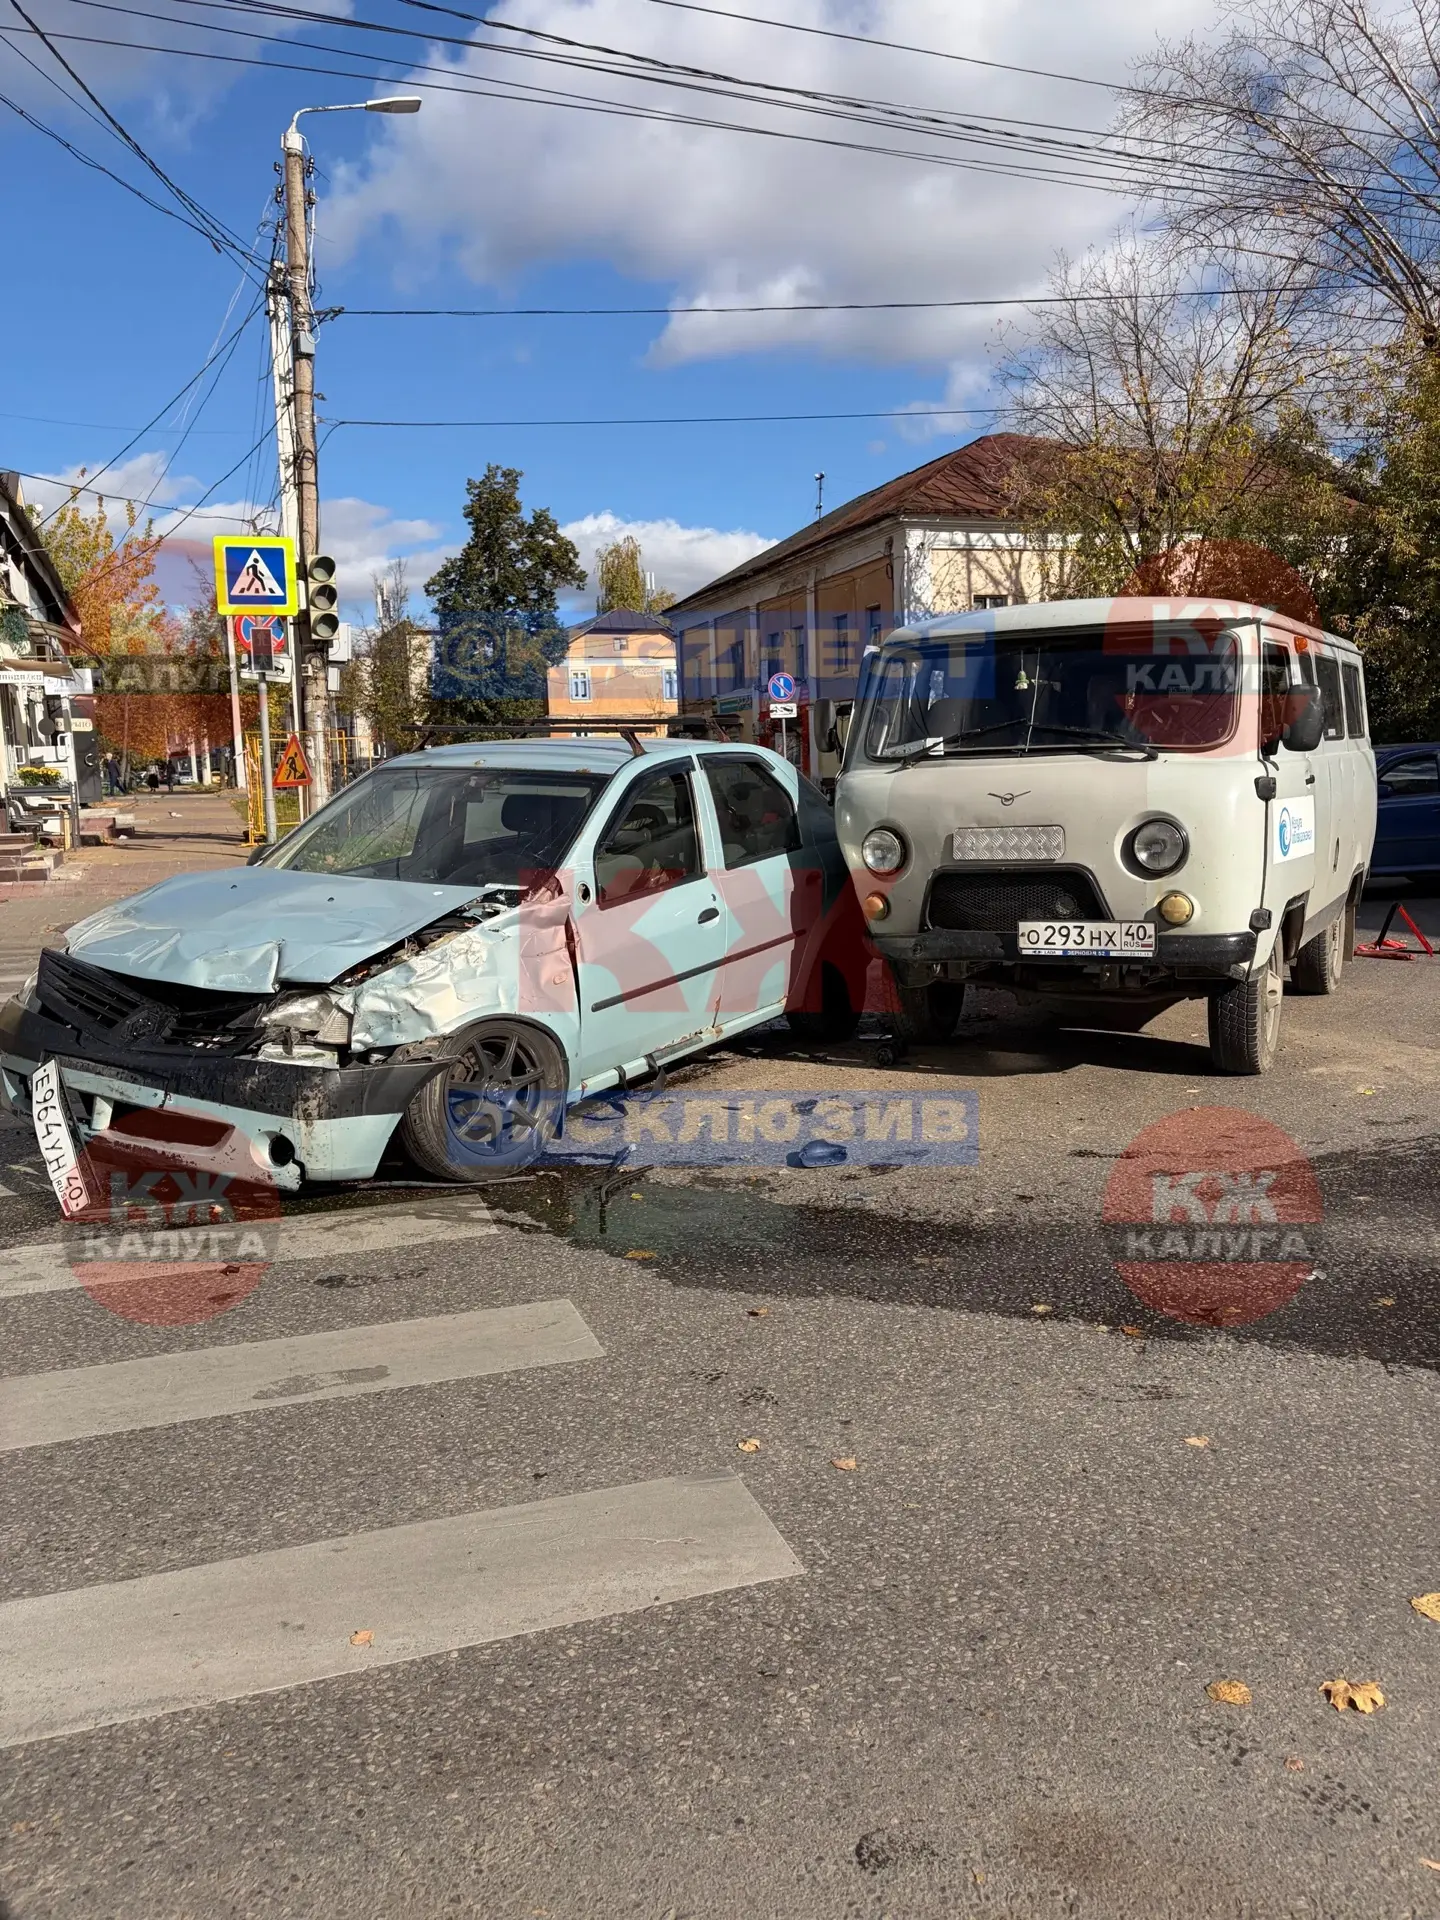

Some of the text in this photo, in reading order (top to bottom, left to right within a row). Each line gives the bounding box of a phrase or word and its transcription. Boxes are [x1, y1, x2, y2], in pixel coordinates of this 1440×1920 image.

[1124, 925, 1147, 941] 40
[55, 1180, 67, 1199] RUS
[66, 1176, 83, 1200] 40
